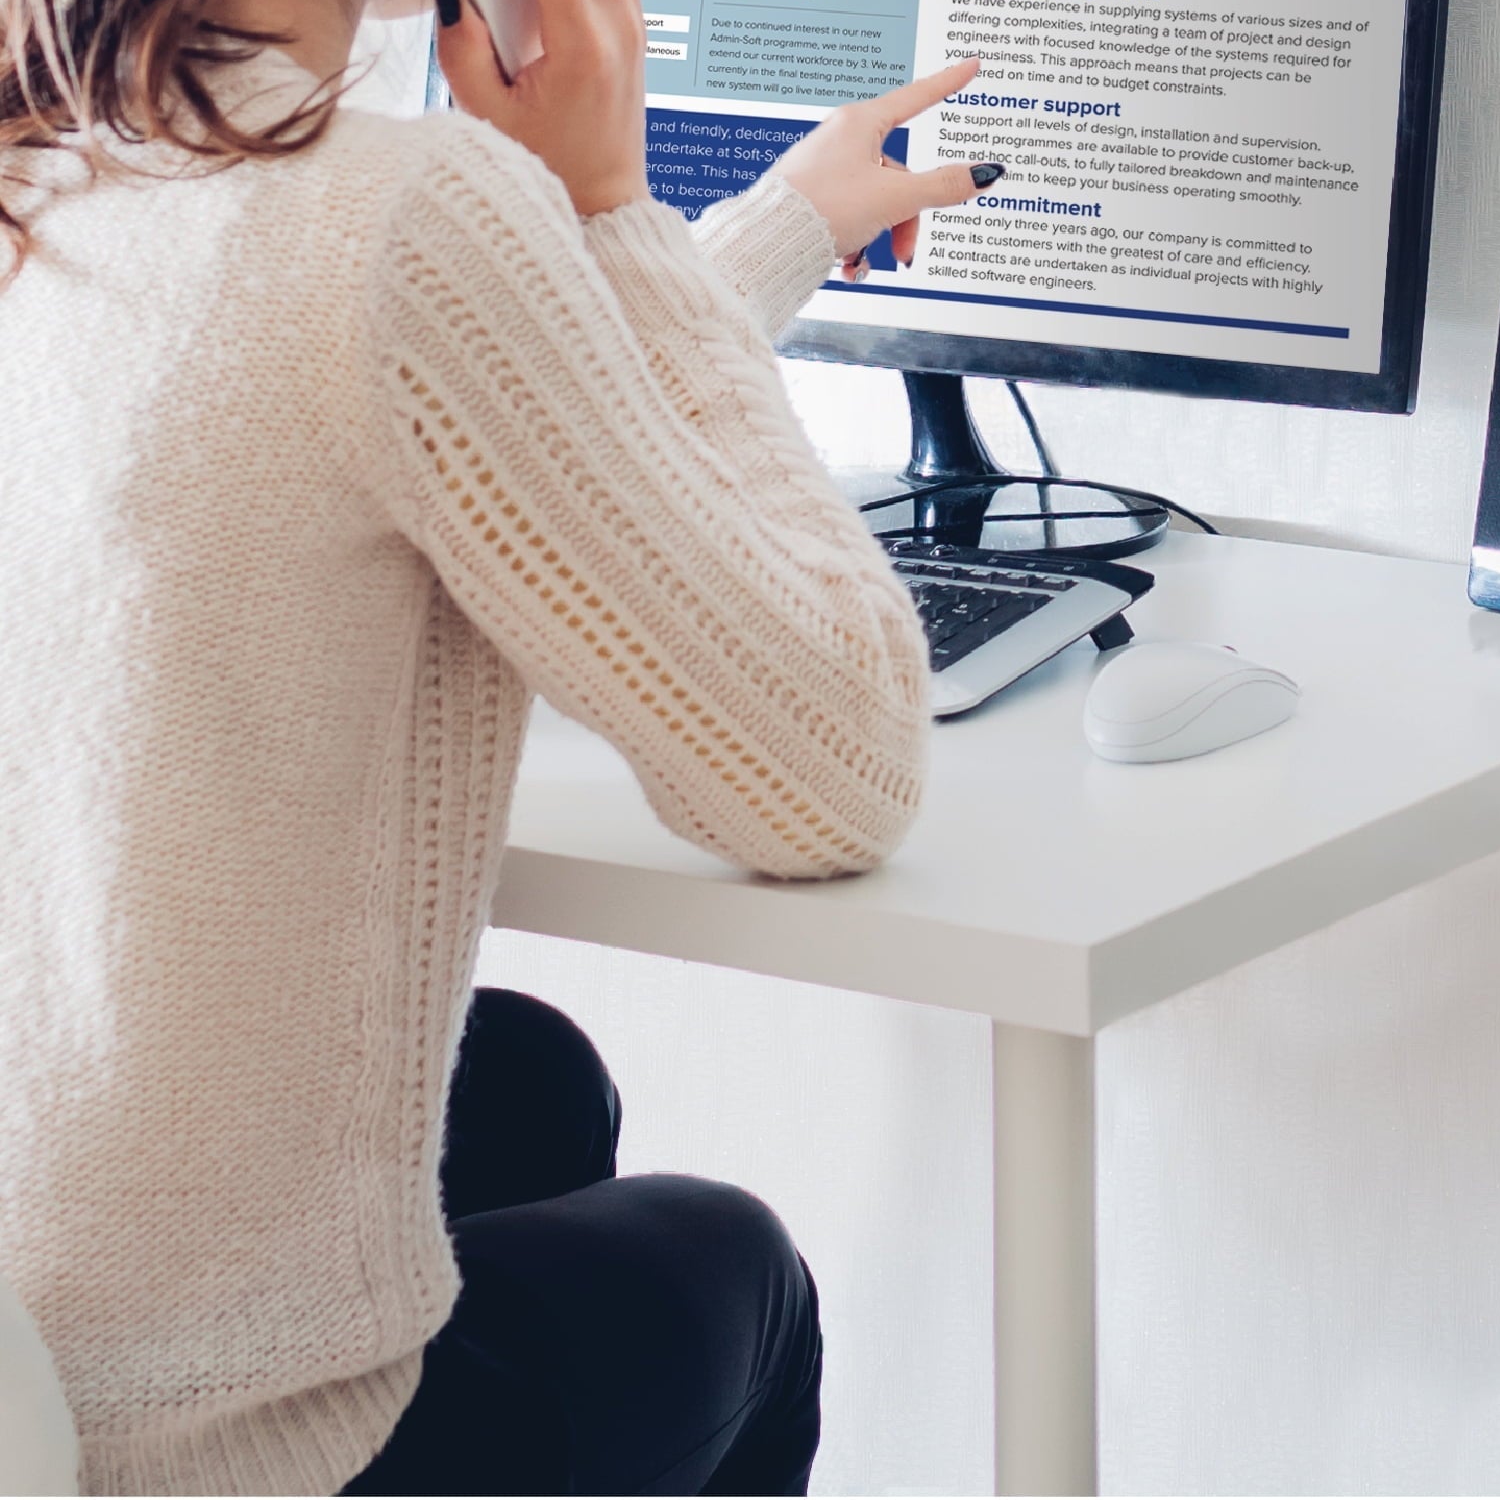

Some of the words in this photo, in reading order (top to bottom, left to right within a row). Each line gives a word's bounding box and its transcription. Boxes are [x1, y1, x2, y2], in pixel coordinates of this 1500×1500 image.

[1008, 0, 1081, 14] experience
[1083, 2, 1095, 14] in
[1098, 5, 1161, 21] supplying
[1164, 9, 1217, 23] systems
[1221, 12, 1235, 23] of
[1237, 14, 1285, 27] various
[1288, 17, 1323, 29] sizes
[1326, 20, 1352, 31] and
[1355, 20, 1370, 32] of
[711, 17, 732, 28] Due
[733, 20, 743, 29] to
[744, 21, 792, 32] continued
[793, 23, 830, 35] interest
[831, 26, 840, 35] in
[841, 28, 859, 37] our
[860, 29, 882, 39] new
[944, 92, 1038, 110] Customer
[1043, 99, 1121, 118] support
[650, 121, 676, 133] and
[680, 121, 732, 140] friendly,
[735, 126, 804, 144] dedicated
[940, 111, 961, 123] We
[964, 115, 1013, 127] support
[1015, 117, 1031, 128] all
[1033, 118, 1071, 132] levels
[1074, 121, 1088, 132] of
[1090, 123, 1137, 139] design,
[1140, 126, 1210, 142] installation
[1212, 133, 1239, 145] and
[1241, 136, 1321, 151] supervision.
[644, 141, 713, 156] undertake
[716, 147, 730, 158] at
[700, 164, 729, 178] This
[732, 168, 756, 181] has
[661, 182, 674, 194] to
[679, 184, 734, 198] become
[976, 195, 1102, 218] commitment
[932, 210, 982, 226] Formed
[984, 217, 1012, 231] only
[1014, 218, 1048, 232] three
[1052, 223, 1087, 236] years
[1090, 226, 1118, 240] ago,
[1122, 229, 1144, 240] our
[1148, 231, 1208, 248] company
[1211, 235, 1222, 247] is
[1225, 238, 1296, 253] committed
[1299, 243, 1313, 254] to
